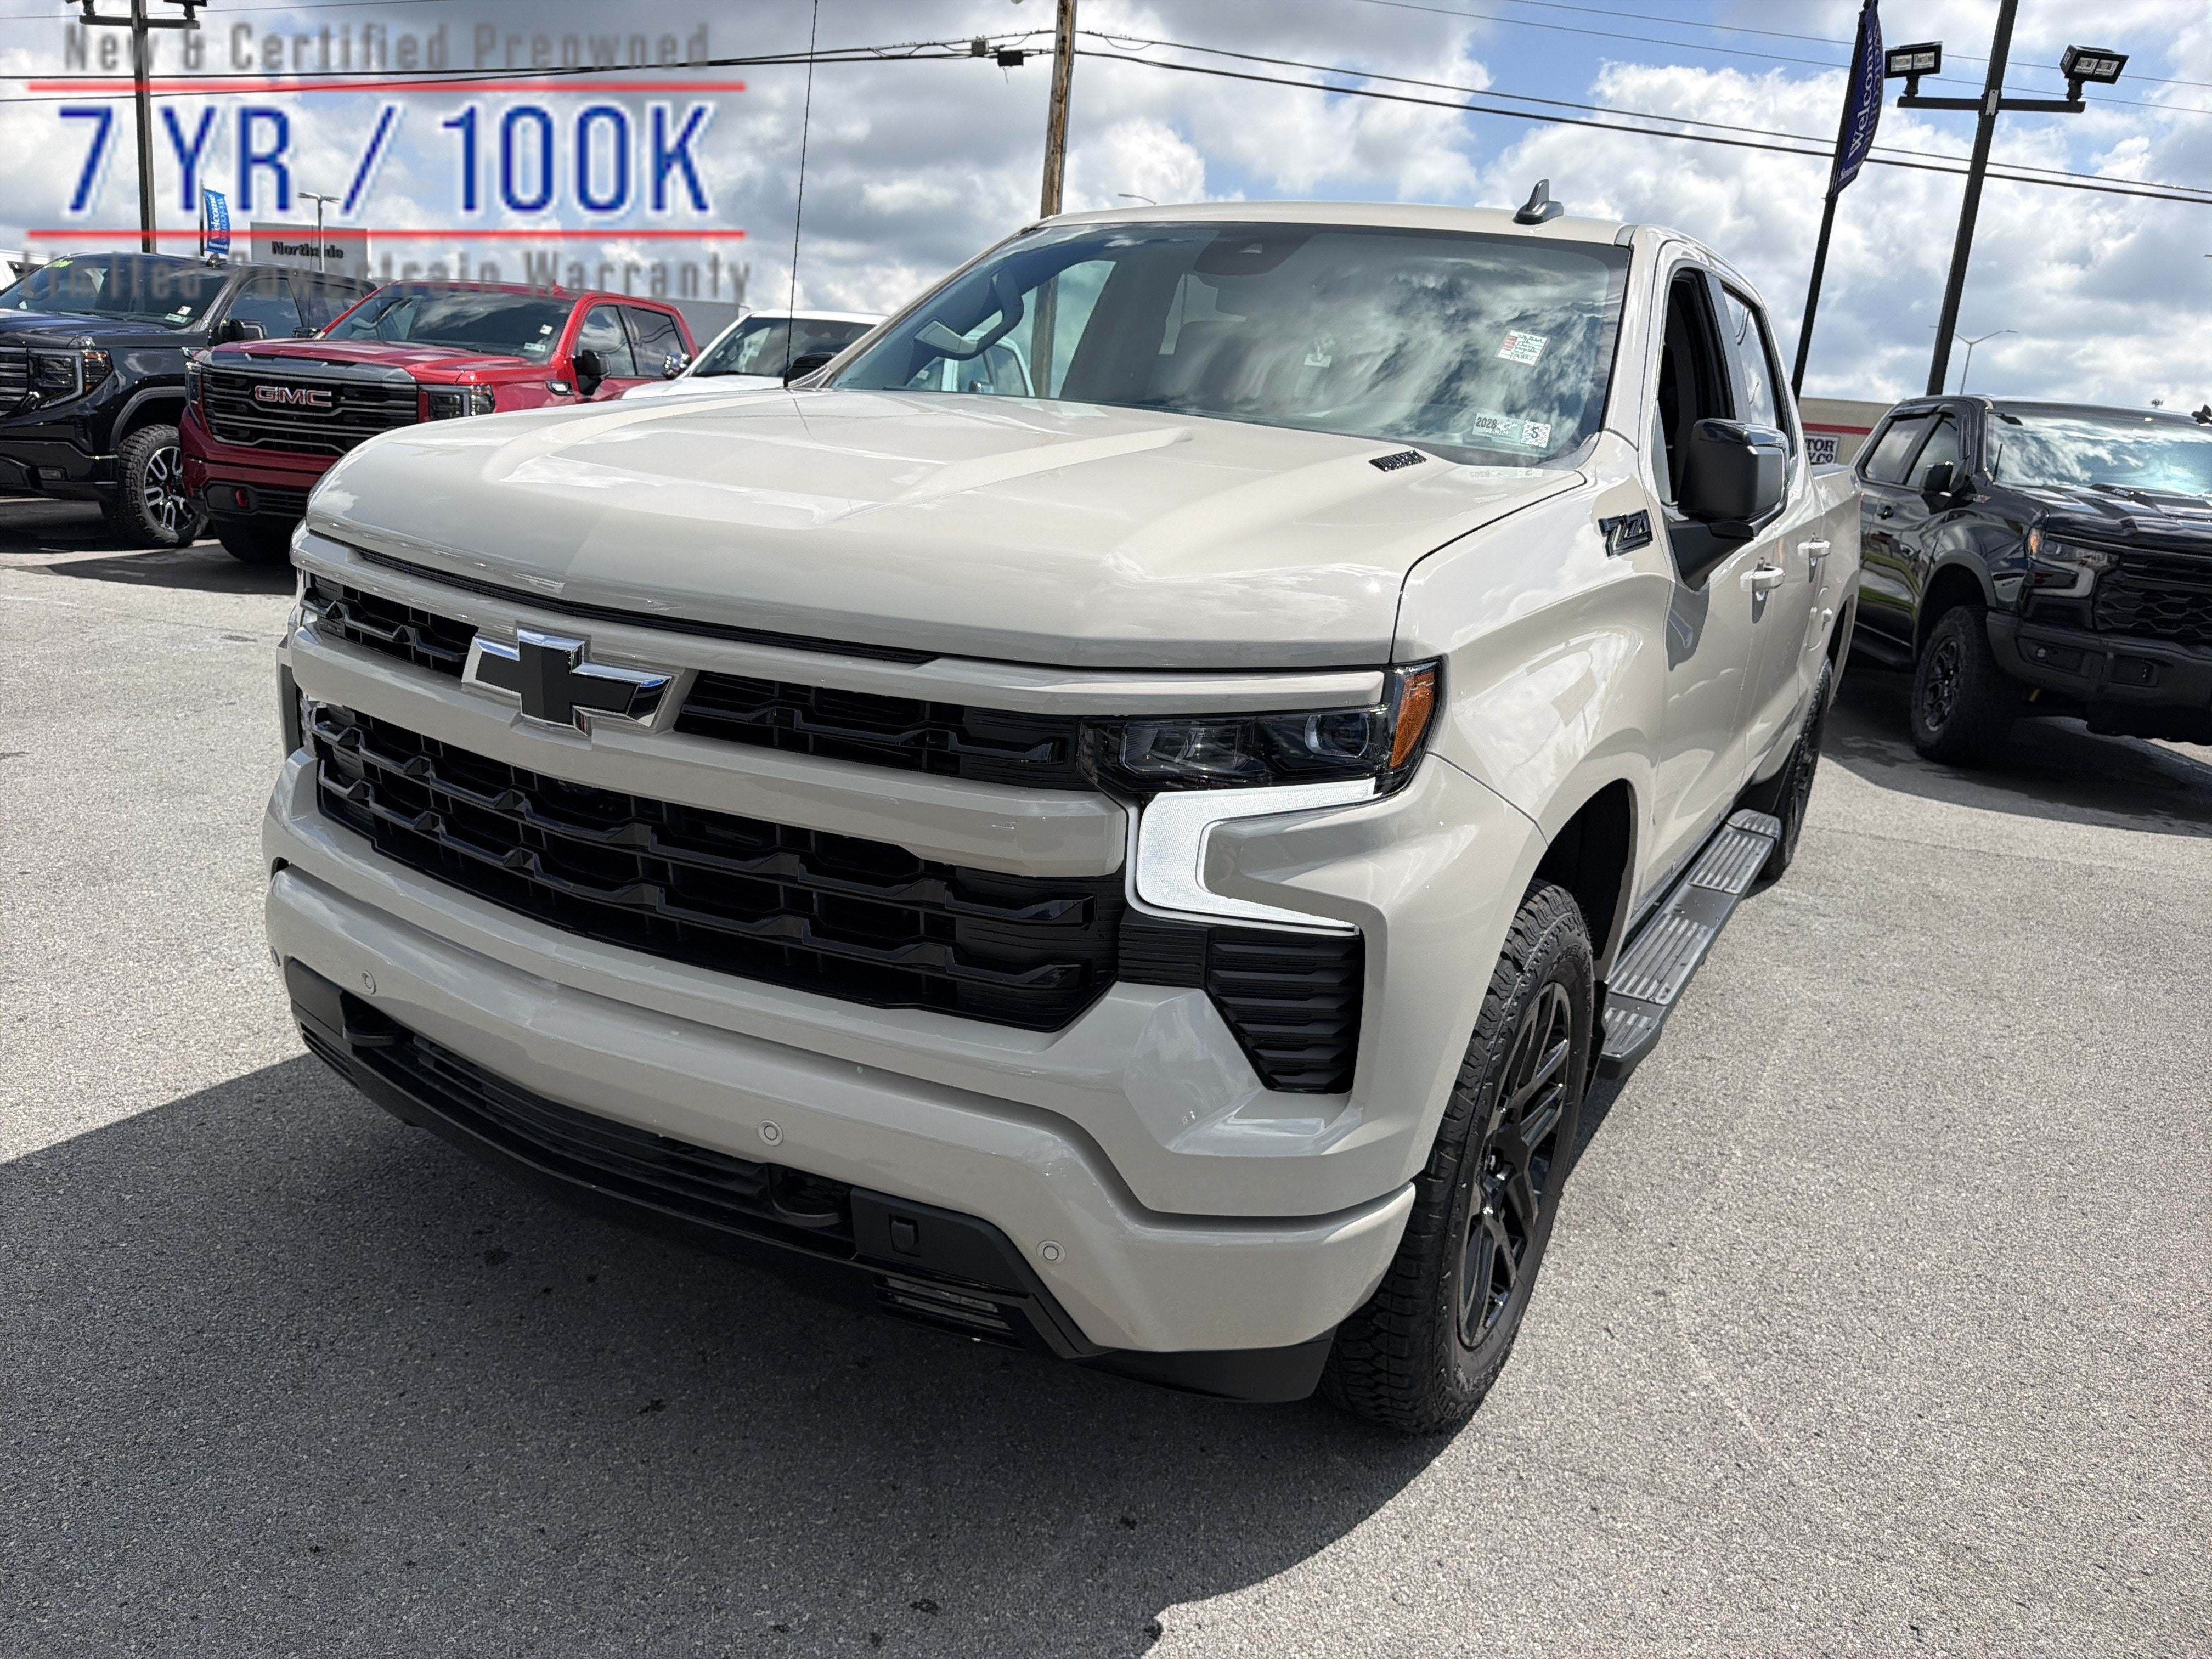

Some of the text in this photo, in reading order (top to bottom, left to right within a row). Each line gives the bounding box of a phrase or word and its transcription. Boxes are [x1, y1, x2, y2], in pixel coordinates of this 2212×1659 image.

[1846, 28, 1874, 160] Welcome
[208, 194, 220, 240] Welcome
[255, 385, 332, 407] GMC
[1475, 417, 1497, 429] 2028
